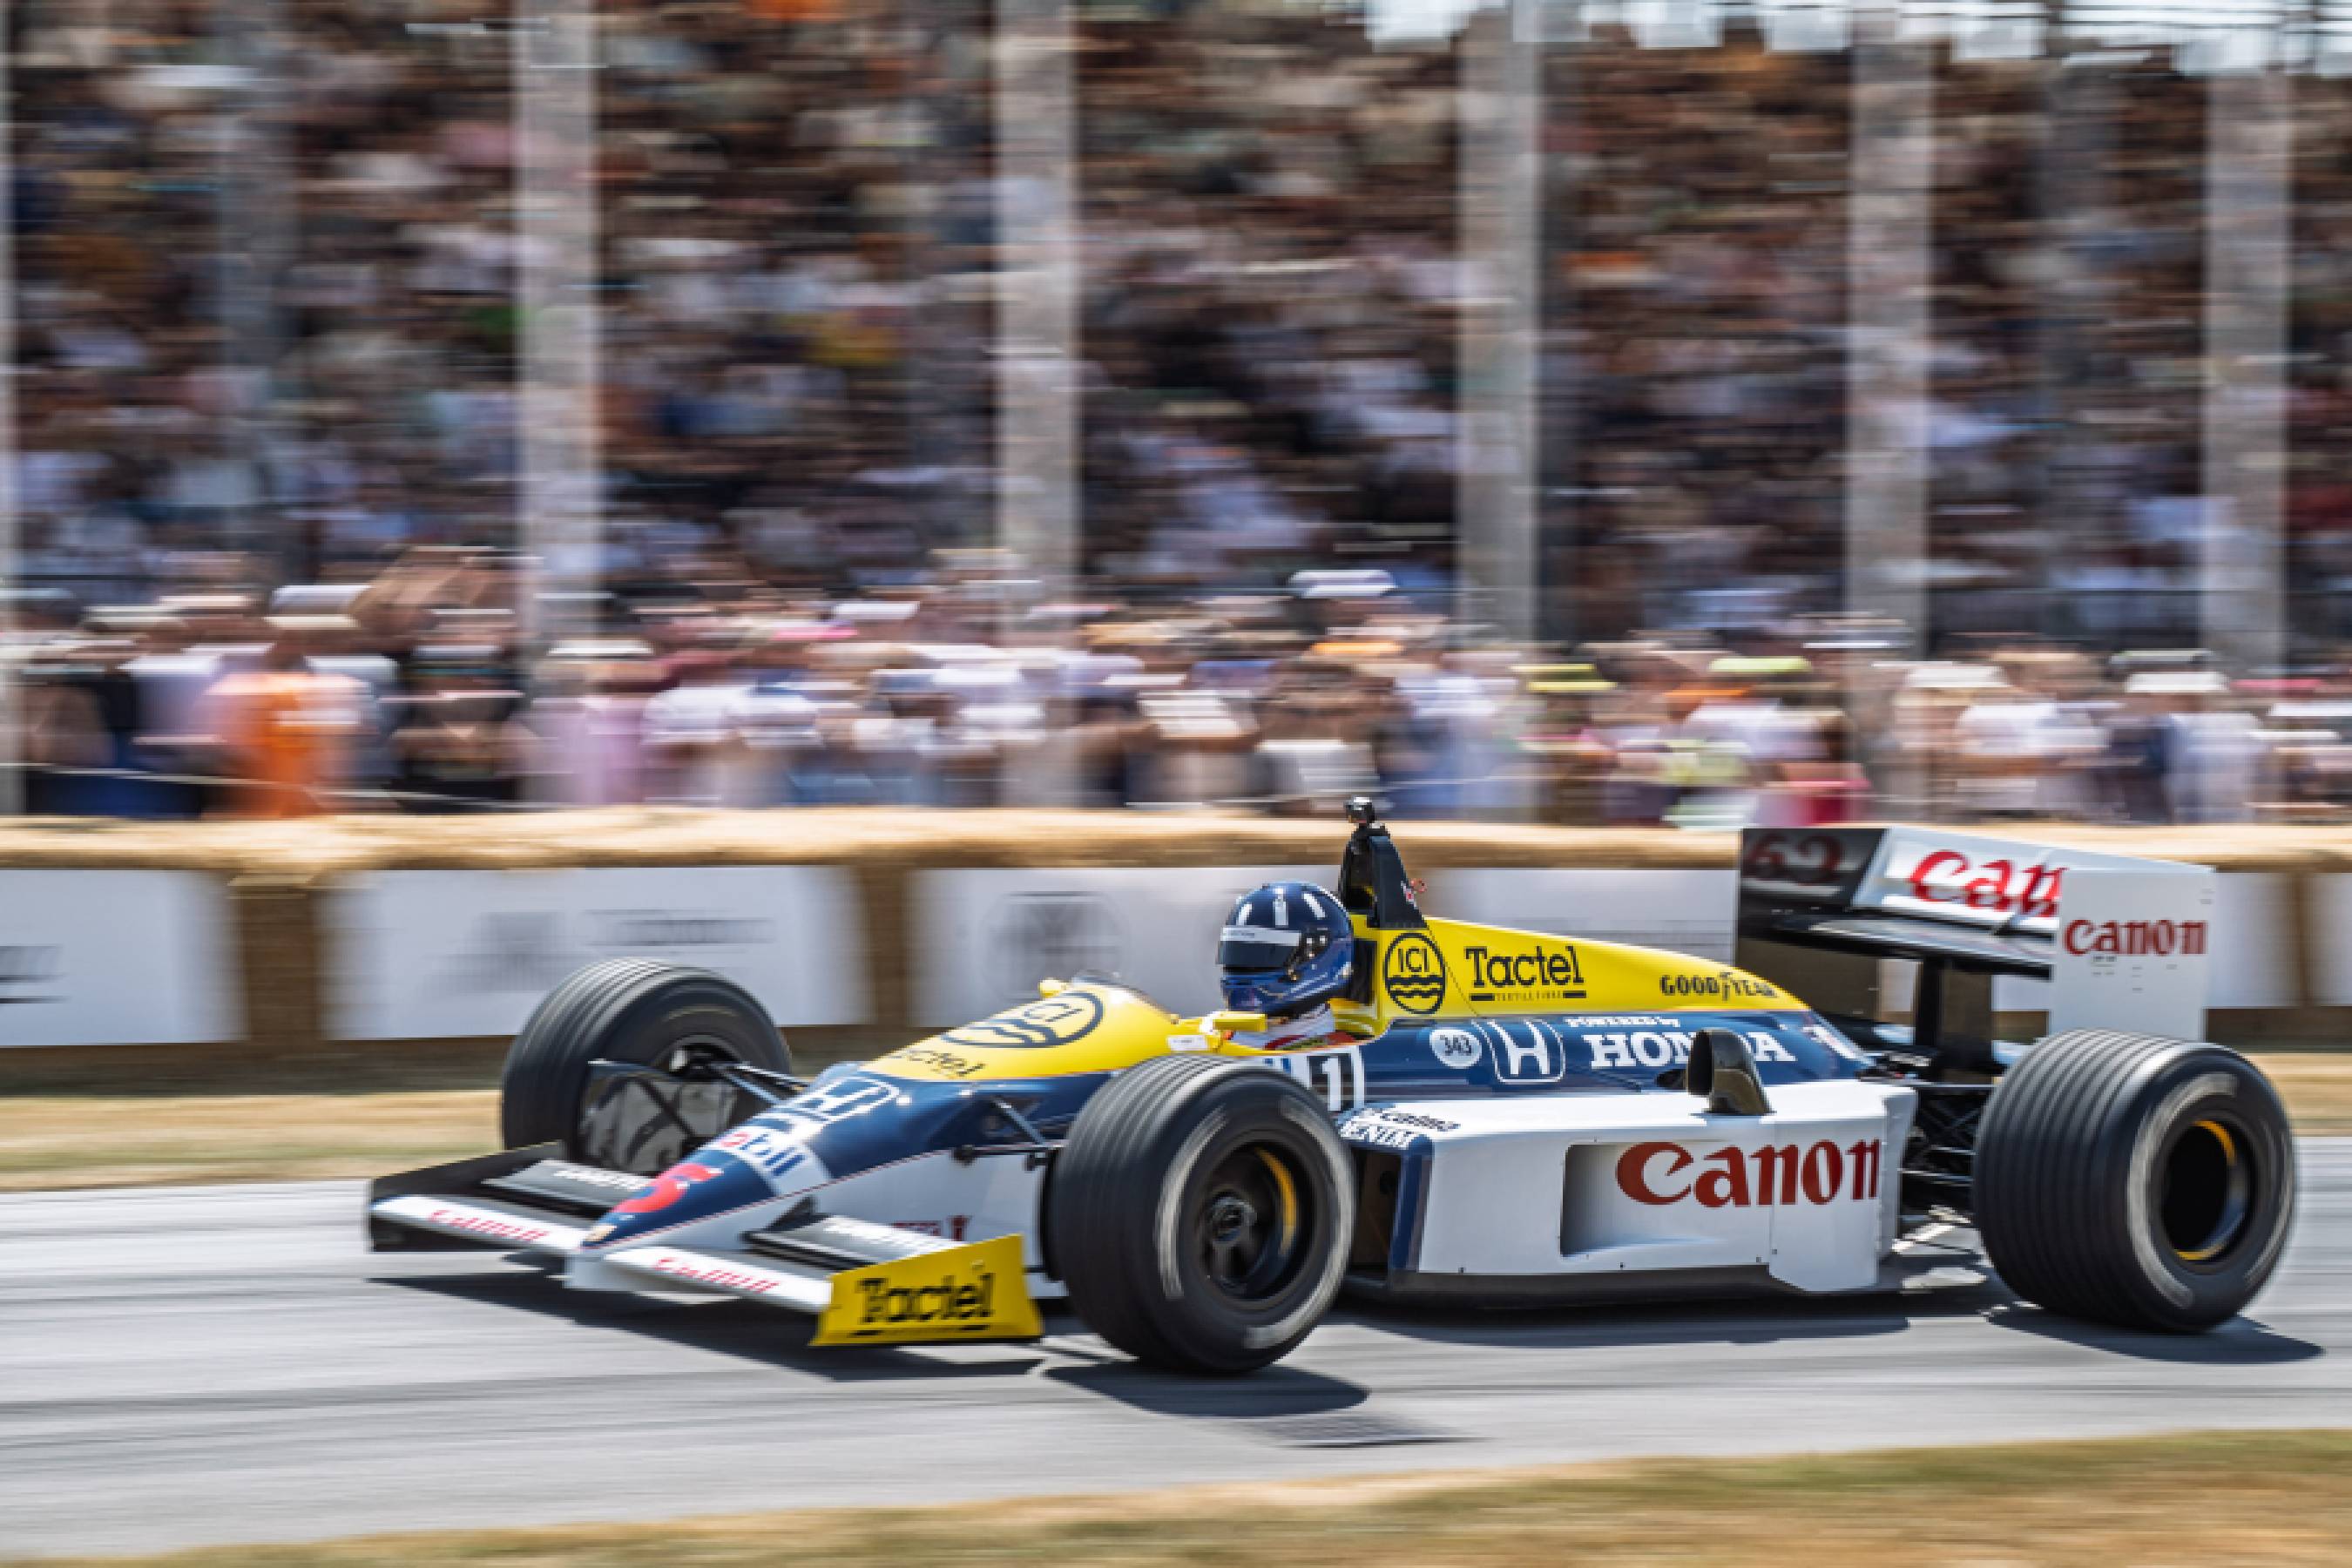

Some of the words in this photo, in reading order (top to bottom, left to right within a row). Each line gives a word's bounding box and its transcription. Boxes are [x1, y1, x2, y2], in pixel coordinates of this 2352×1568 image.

[2064, 919, 2209, 956] Canon
[1396, 946, 1430, 974] ICI
[1463, 944, 1585, 989] Tactel
[1581, 1031, 1797, 1070] HONA
[1615, 1137, 1882, 1208] Canon
[855, 1271, 996, 1323] Tactel
